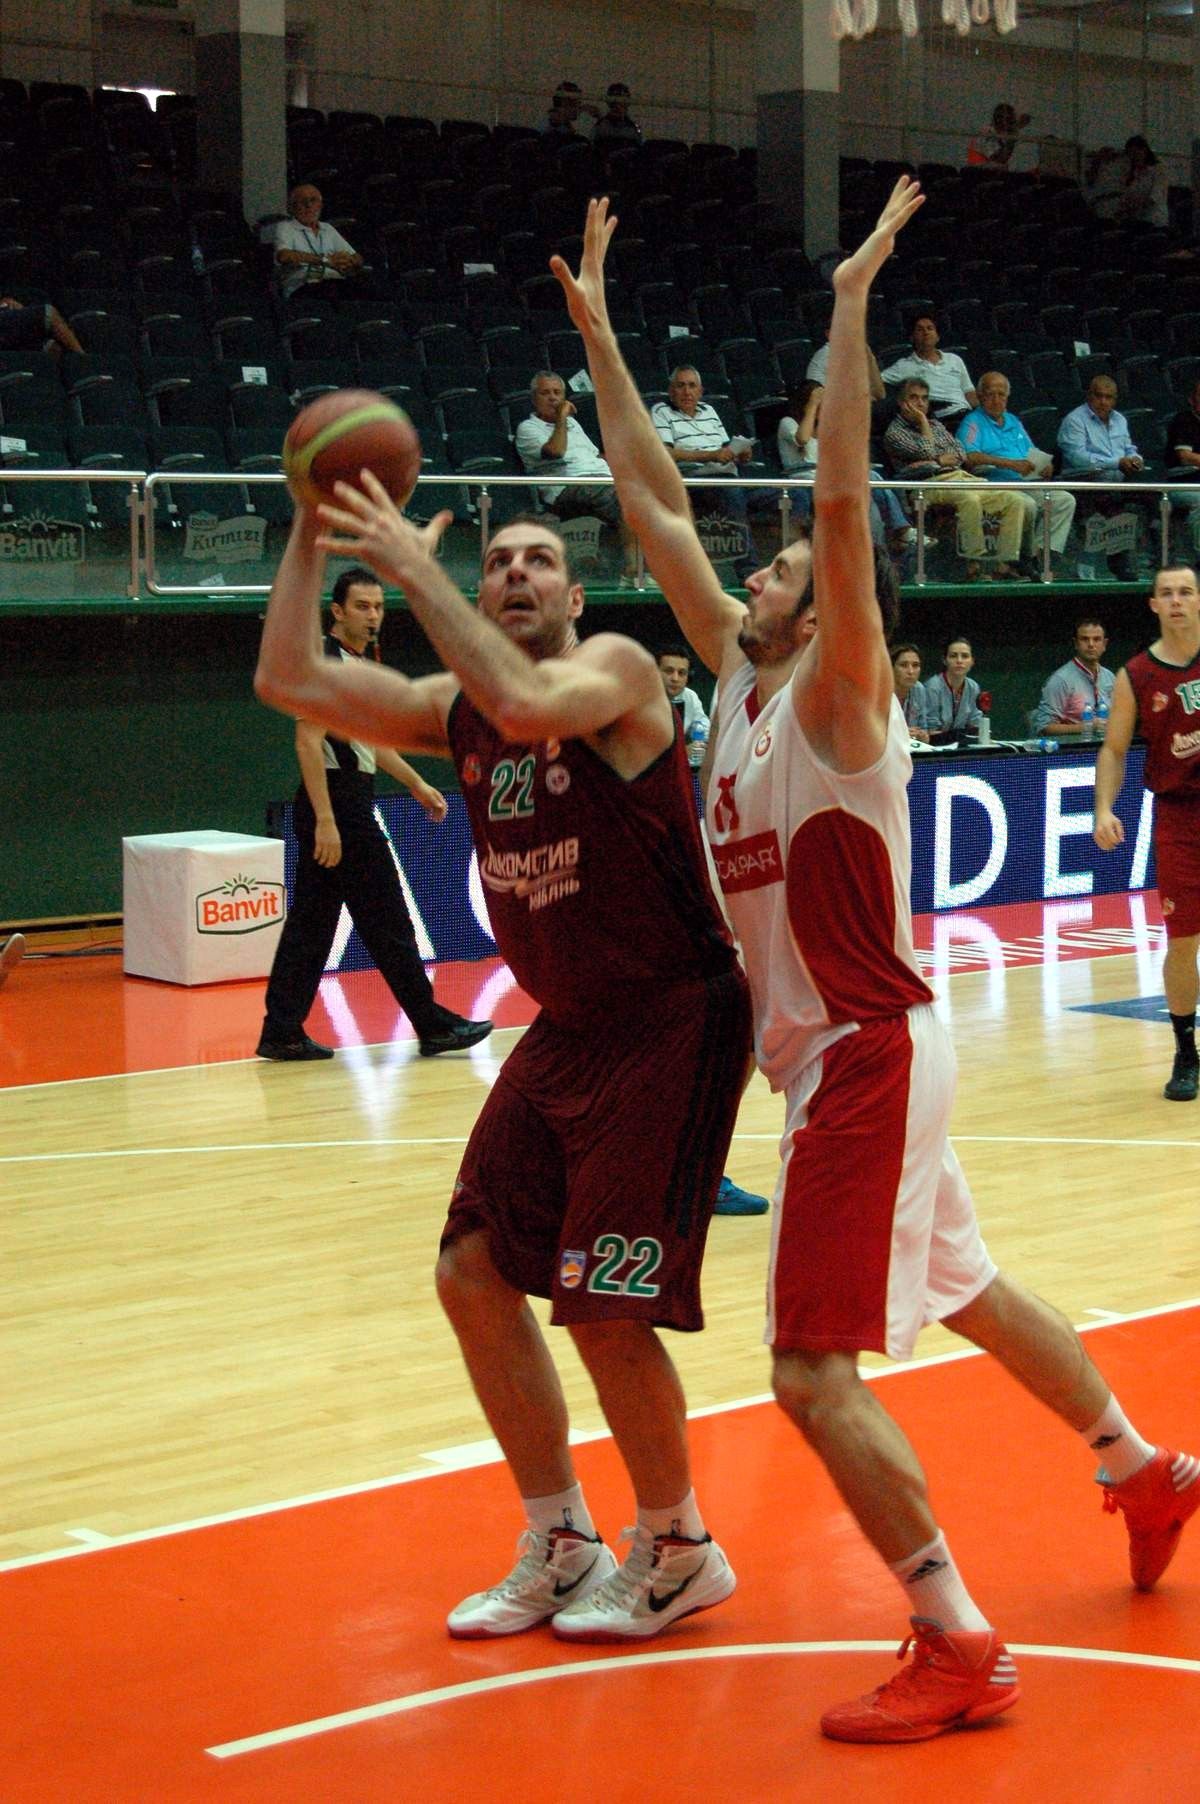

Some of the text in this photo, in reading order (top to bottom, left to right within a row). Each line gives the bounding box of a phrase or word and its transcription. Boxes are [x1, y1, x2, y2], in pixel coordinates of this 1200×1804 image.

[0, 532, 77, 558] Banvit
[699, 530, 744, 554] anvit
[488, 753, 536, 822] 22
[202, 891, 279, 926] Banvit
[587, 1233, 663, 1298] 22
